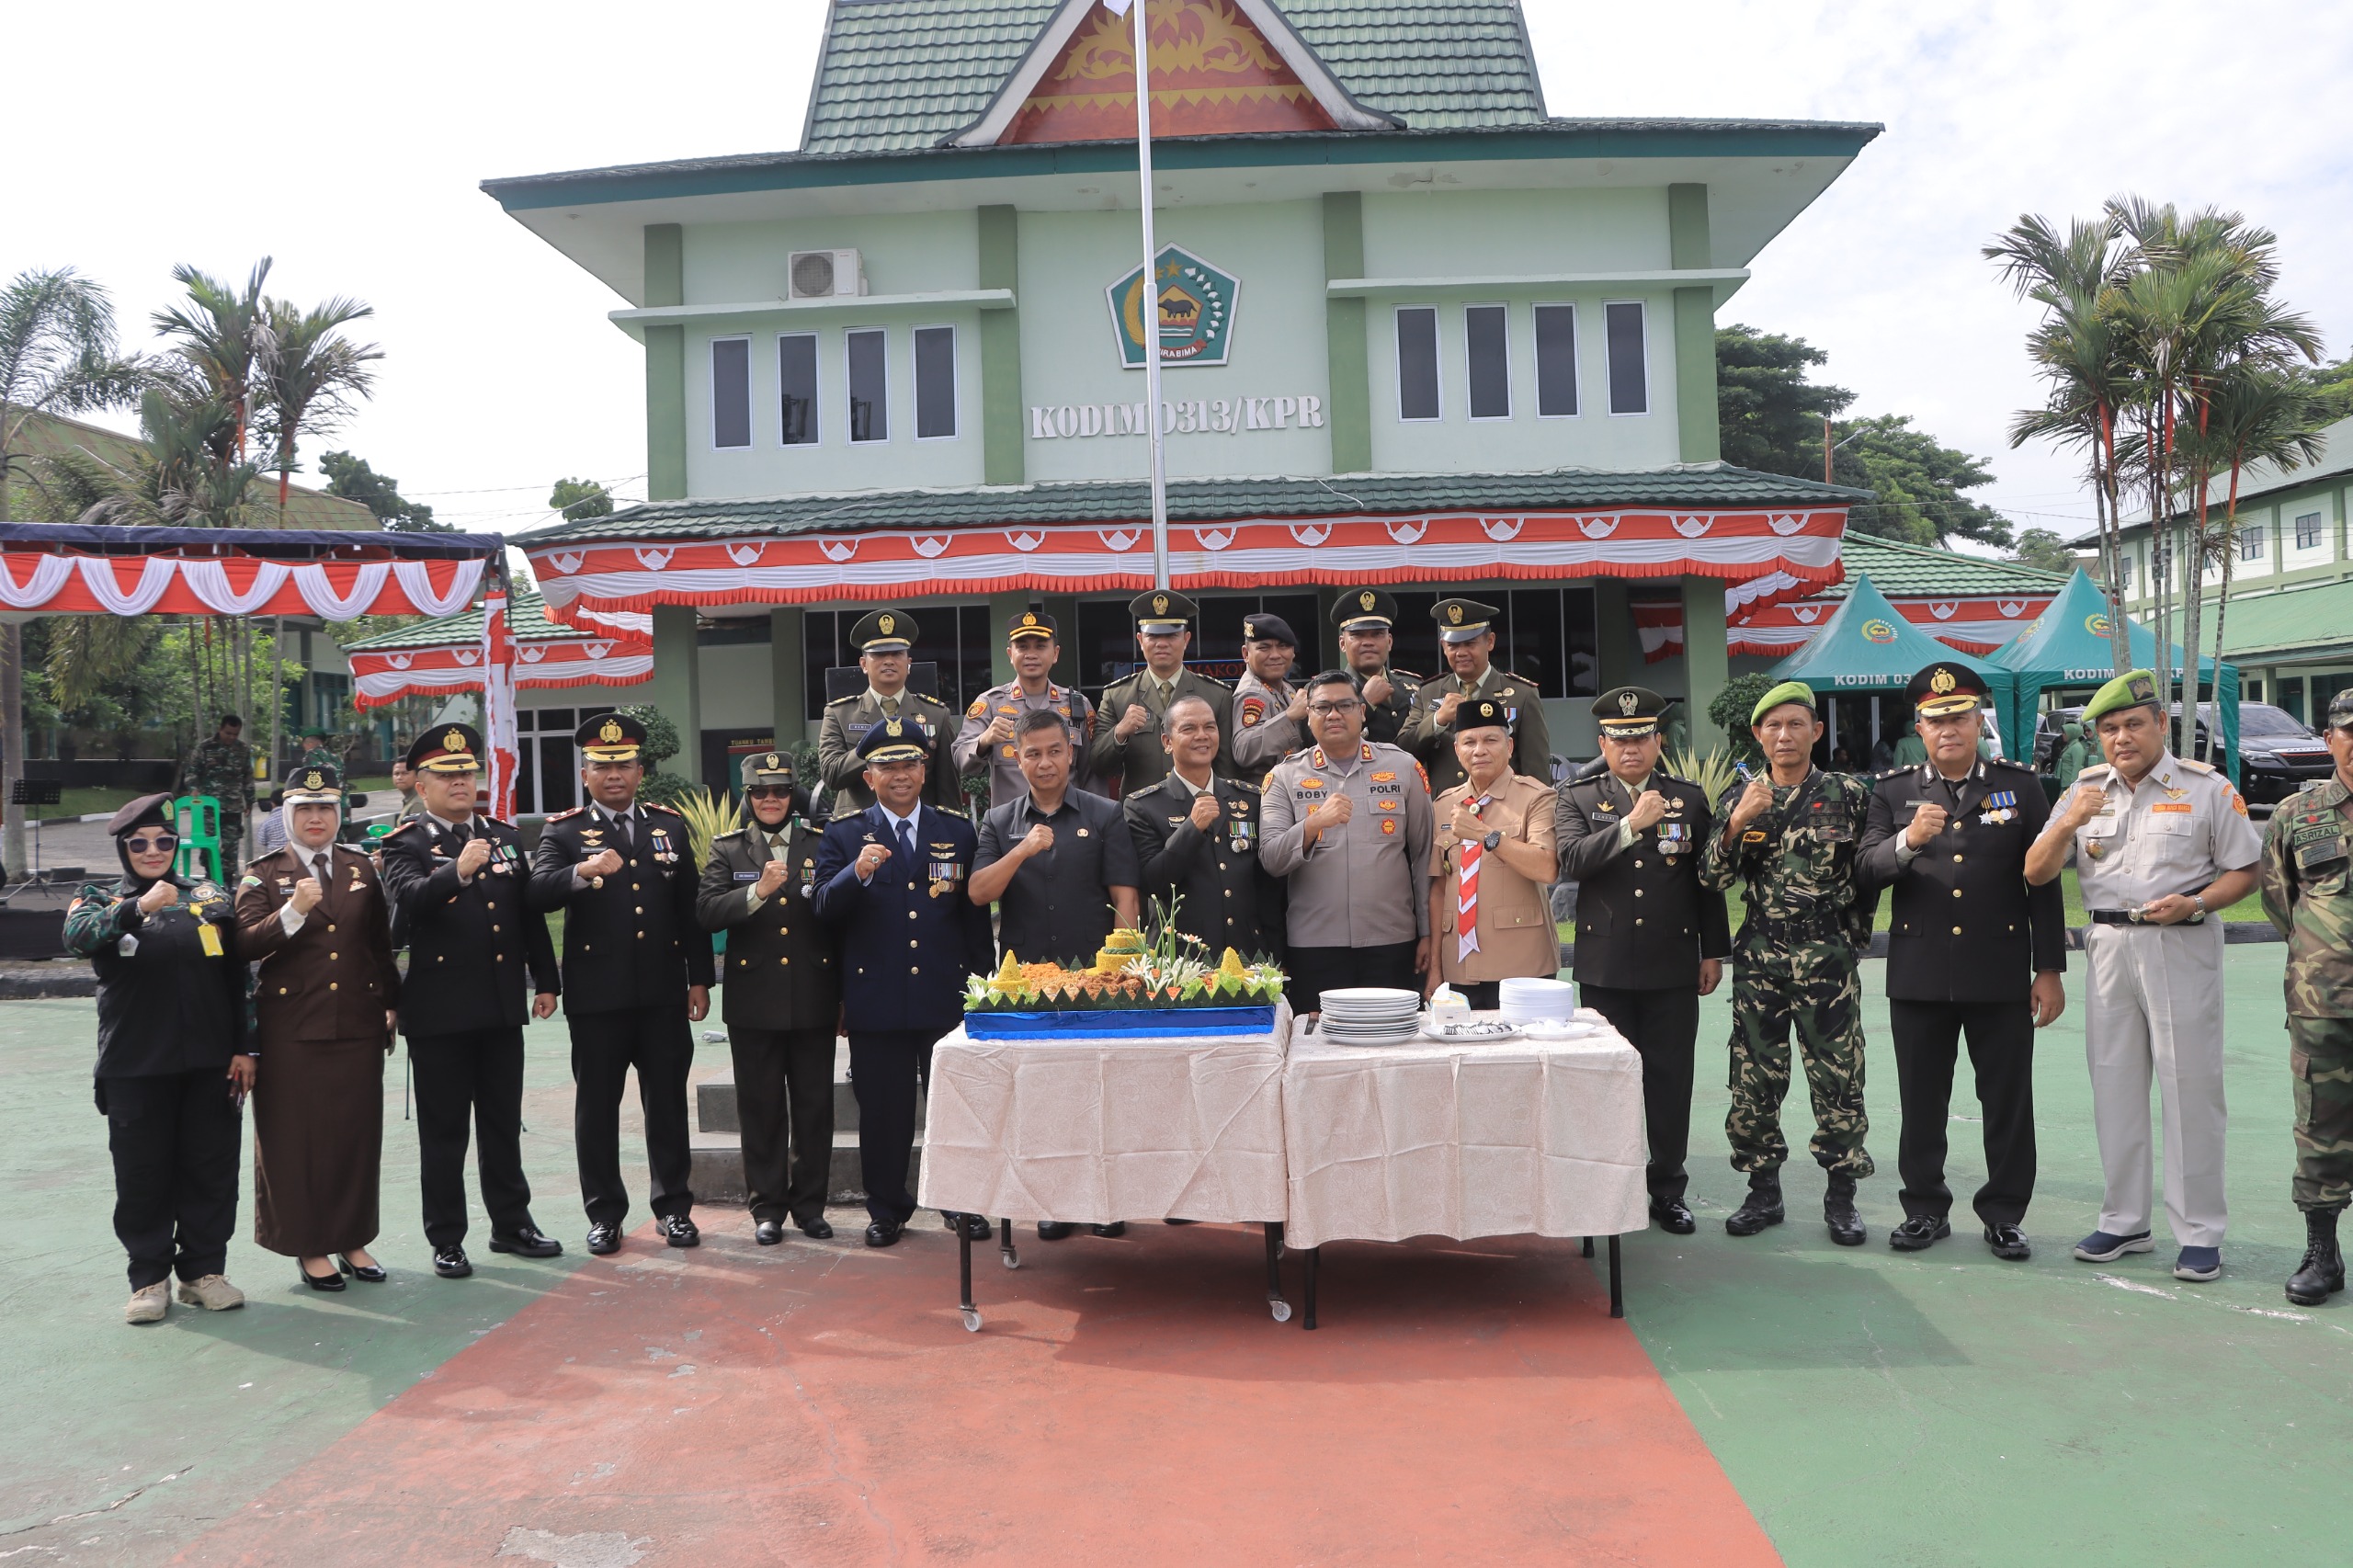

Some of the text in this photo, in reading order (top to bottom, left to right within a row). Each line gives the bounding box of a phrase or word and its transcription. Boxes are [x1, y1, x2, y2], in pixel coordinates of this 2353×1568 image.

[1160, 346, 1197, 358] IRABIMA
[1031, 395, 1324, 438] KODIM 0313/KPR
[1835, 674, 1888, 686] KODIM
[2063, 668, 2115, 680] KODIM
[1296, 790, 1328, 800] BOBY
[1370, 784, 1401, 794] POLRI
[2295, 826, 2338, 844] ASRIZAL
